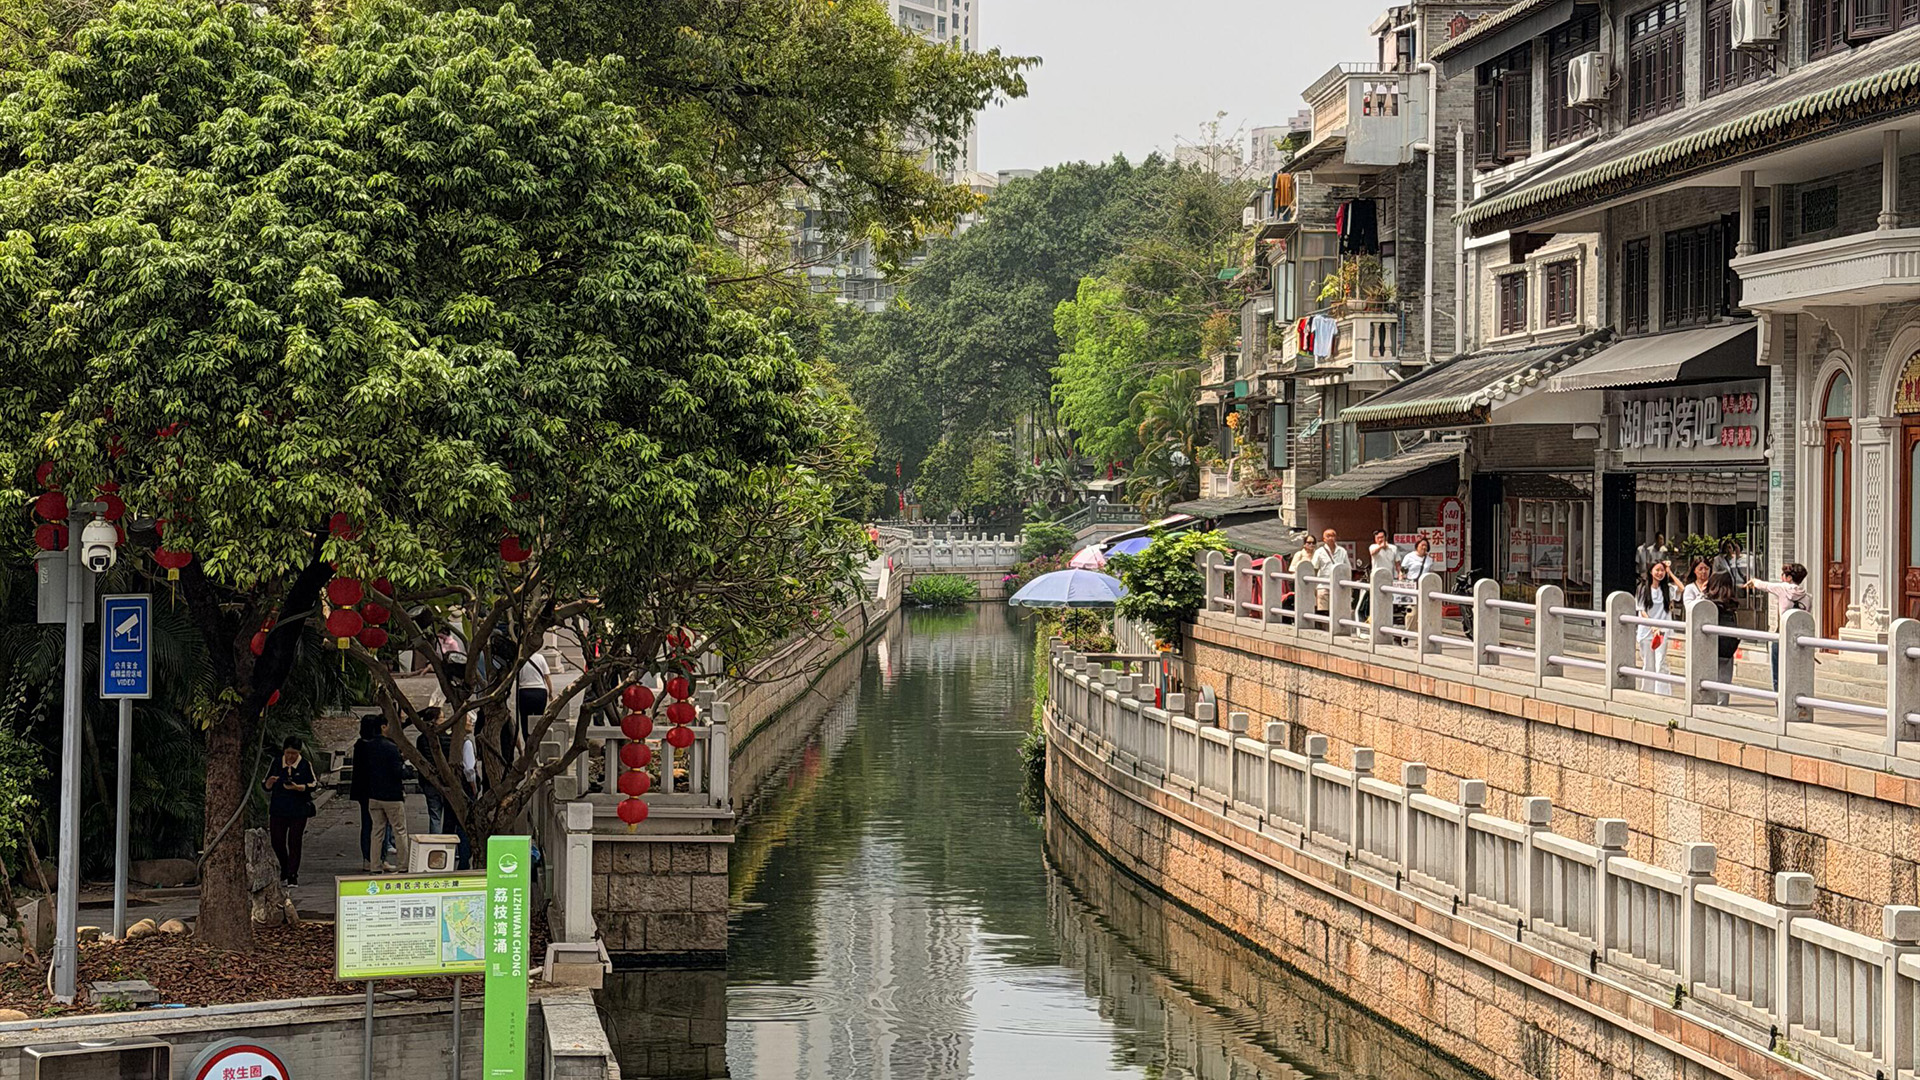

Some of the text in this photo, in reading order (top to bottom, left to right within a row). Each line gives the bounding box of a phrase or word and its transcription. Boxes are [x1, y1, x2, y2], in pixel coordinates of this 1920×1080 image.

[1620, 396, 1718, 449] 湖畔烤吧
[1420, 529, 1445, 545] 牛杂
[1445, 509, 1459, 560] 湖畔烤吧
[117, 678, 135, 686] VIDEO
[493, 887, 508, 954] 荔枝湾涌
[512, 887, 522, 977] LIZHIWAN CHONG
[222, 1065, 262, 1080] 救生圈
